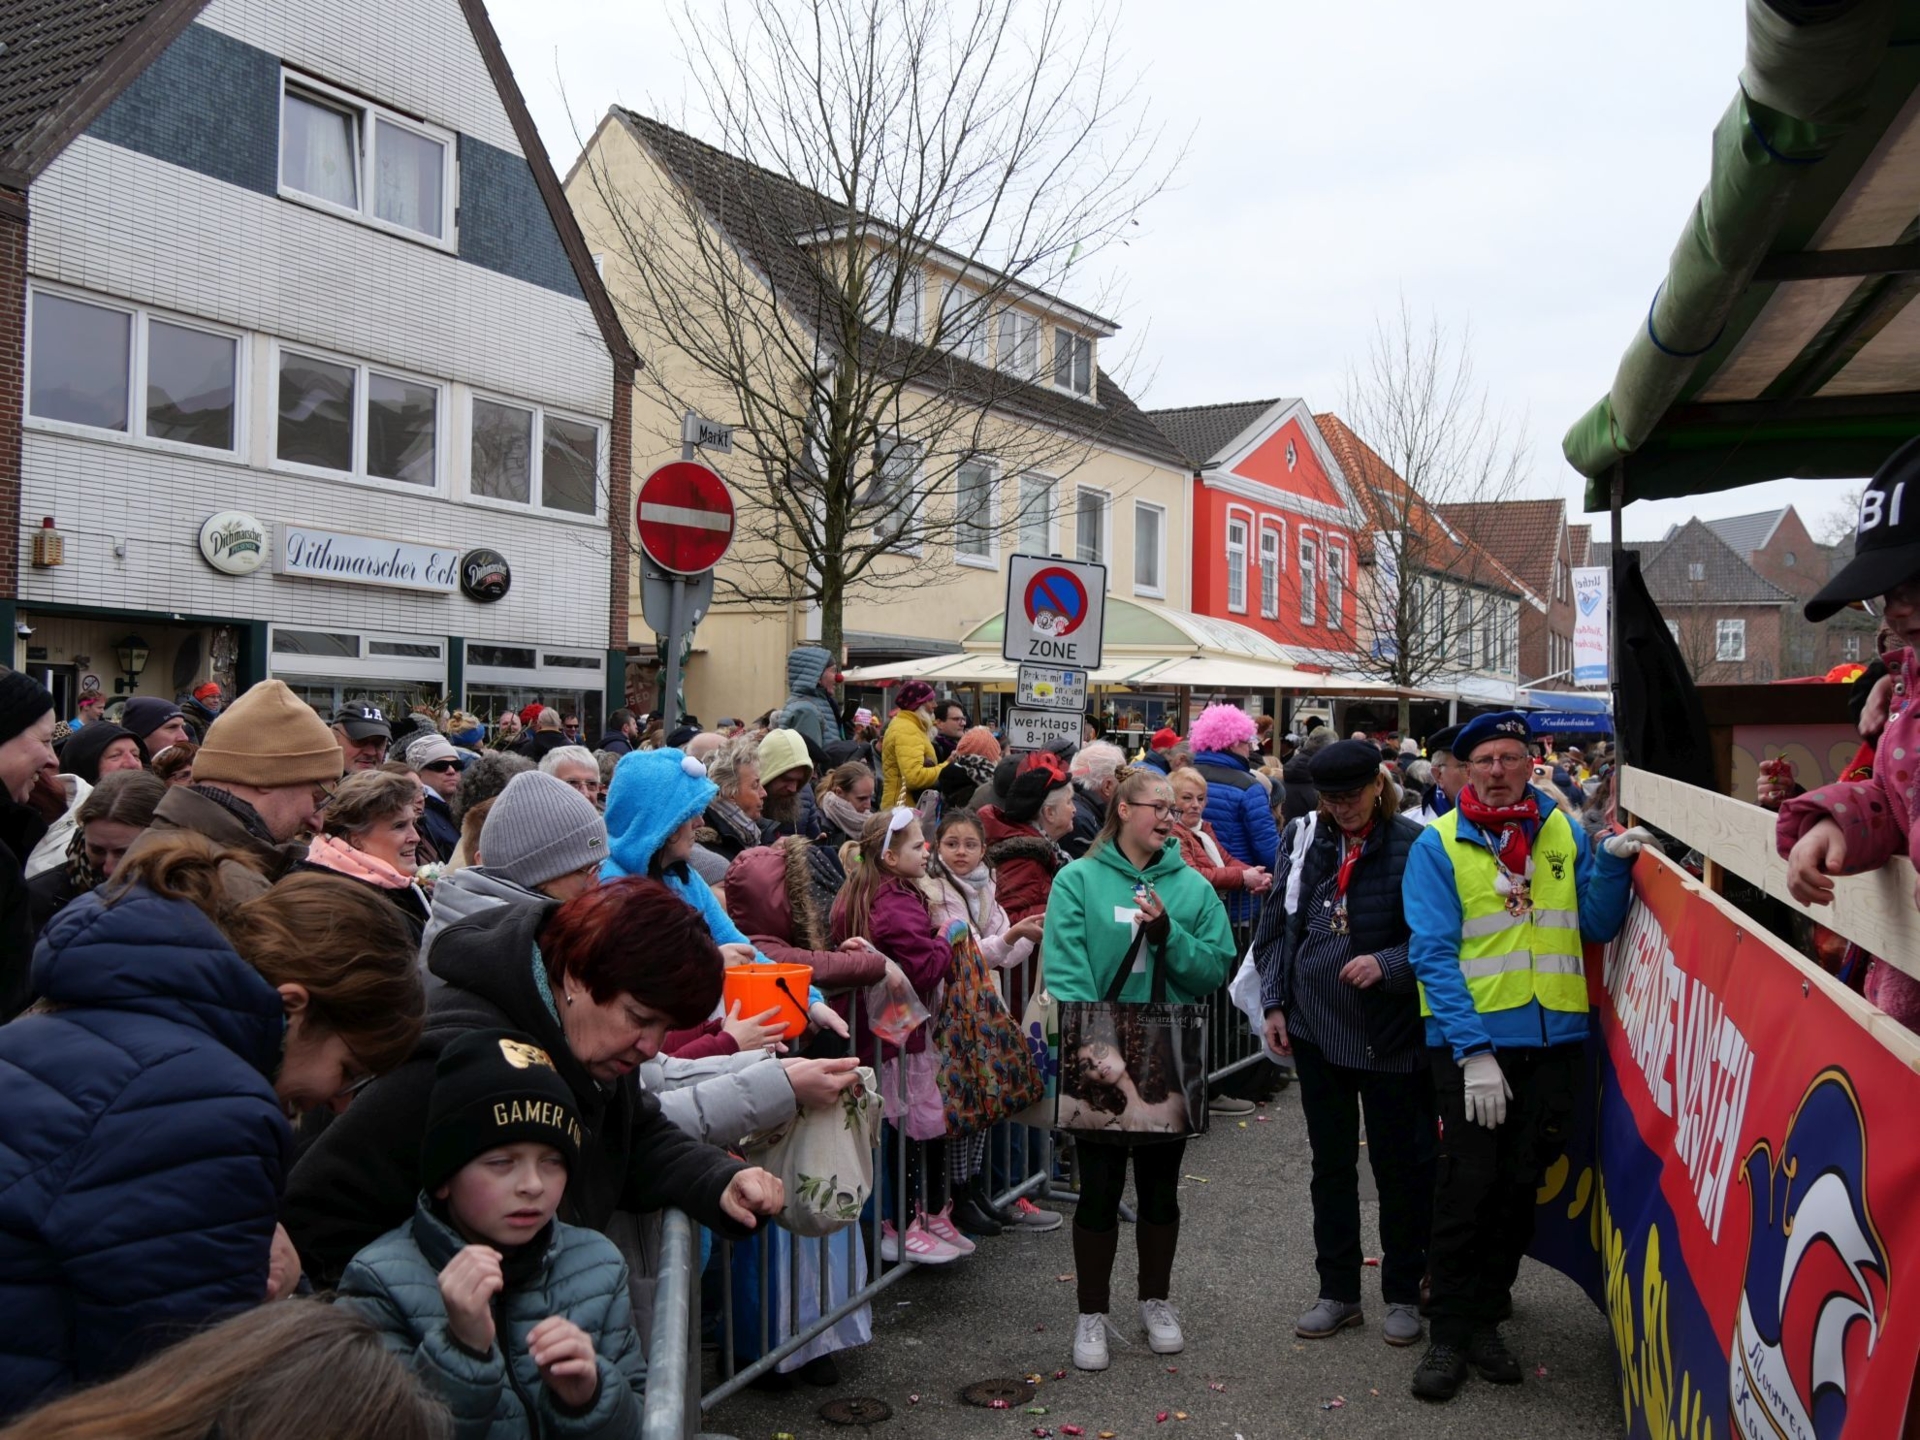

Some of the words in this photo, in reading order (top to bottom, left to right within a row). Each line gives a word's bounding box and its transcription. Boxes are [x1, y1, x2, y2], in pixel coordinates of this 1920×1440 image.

[699, 424, 728, 448] Markt
[287, 532, 416, 580] Dithmarscher
[425, 552, 457, 585] Eck
[1029, 639, 1077, 660] ZONE
[363, 707, 383, 721] LA
[1014, 717, 1078, 733] werktags
[493, 1100, 564, 1129] GAMER
